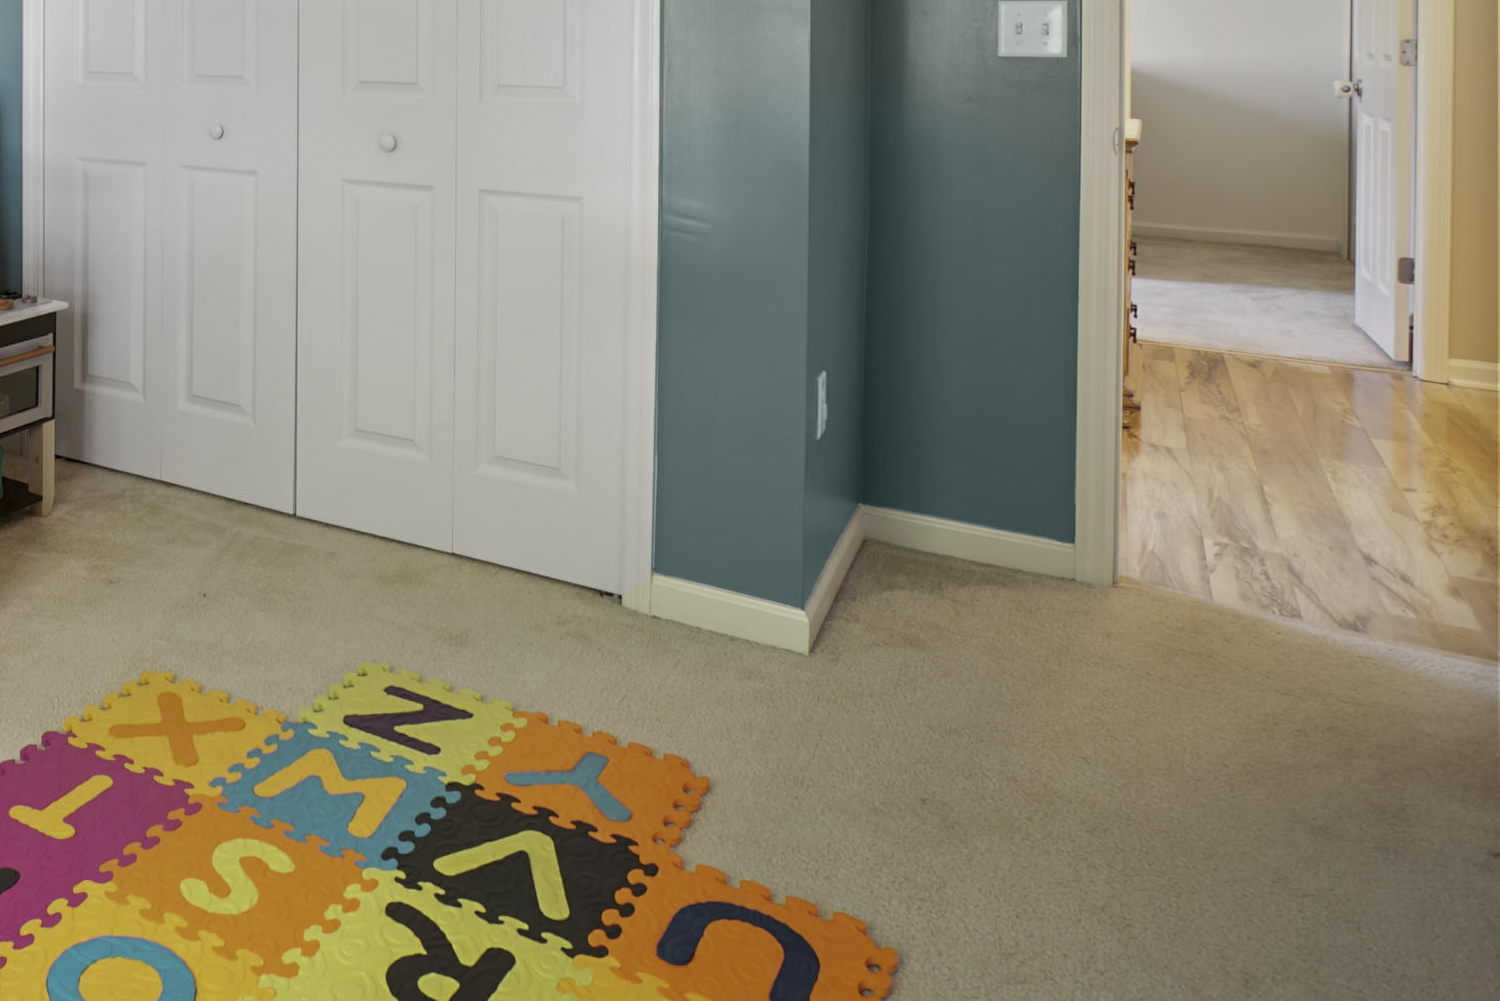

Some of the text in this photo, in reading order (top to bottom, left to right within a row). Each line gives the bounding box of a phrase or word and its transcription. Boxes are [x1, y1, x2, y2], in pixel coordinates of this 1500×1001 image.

[107, 690, 248, 768] X
[10, 775, 112, 838] T
[504, 752, 632, 822] Y
[180, 838, 295, 915] S
